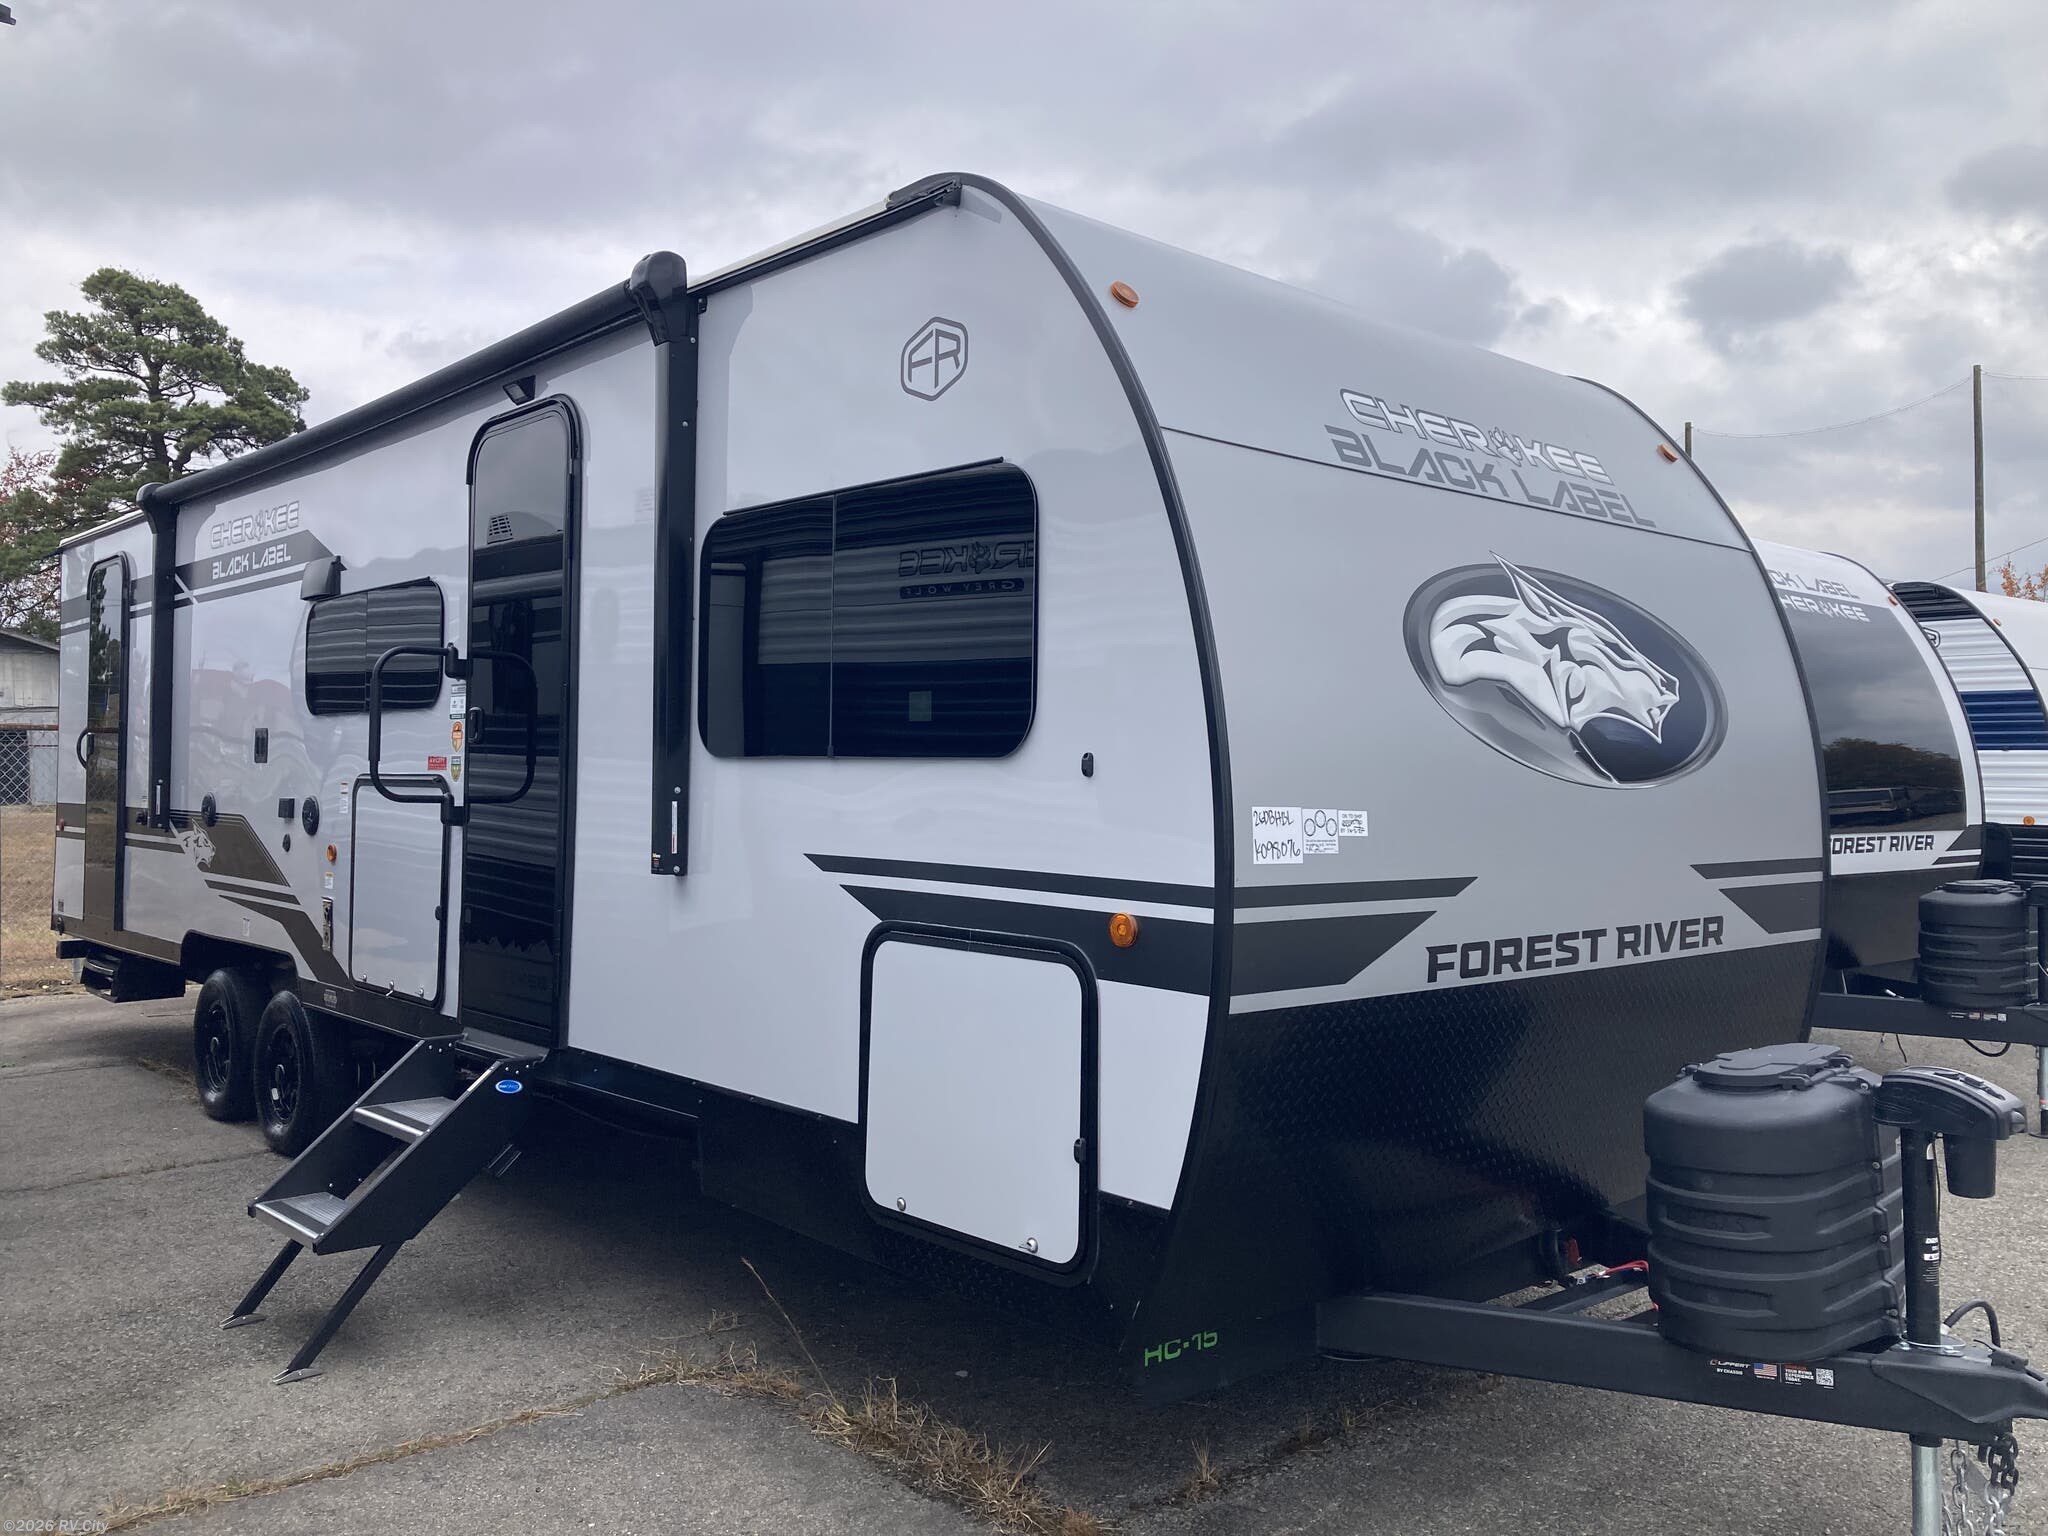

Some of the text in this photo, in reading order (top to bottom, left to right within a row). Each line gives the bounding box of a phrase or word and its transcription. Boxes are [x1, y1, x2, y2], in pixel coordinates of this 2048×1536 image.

[1324, 424, 1656, 527] BLACK LABEL
[212, 543, 292, 580] BLACK LABEL
[1796, 574, 1861, 599] LABEL
[1831, 834, 1935, 855] OREST RIVER
[1425, 915, 1725, 983] FOREST RIVER
